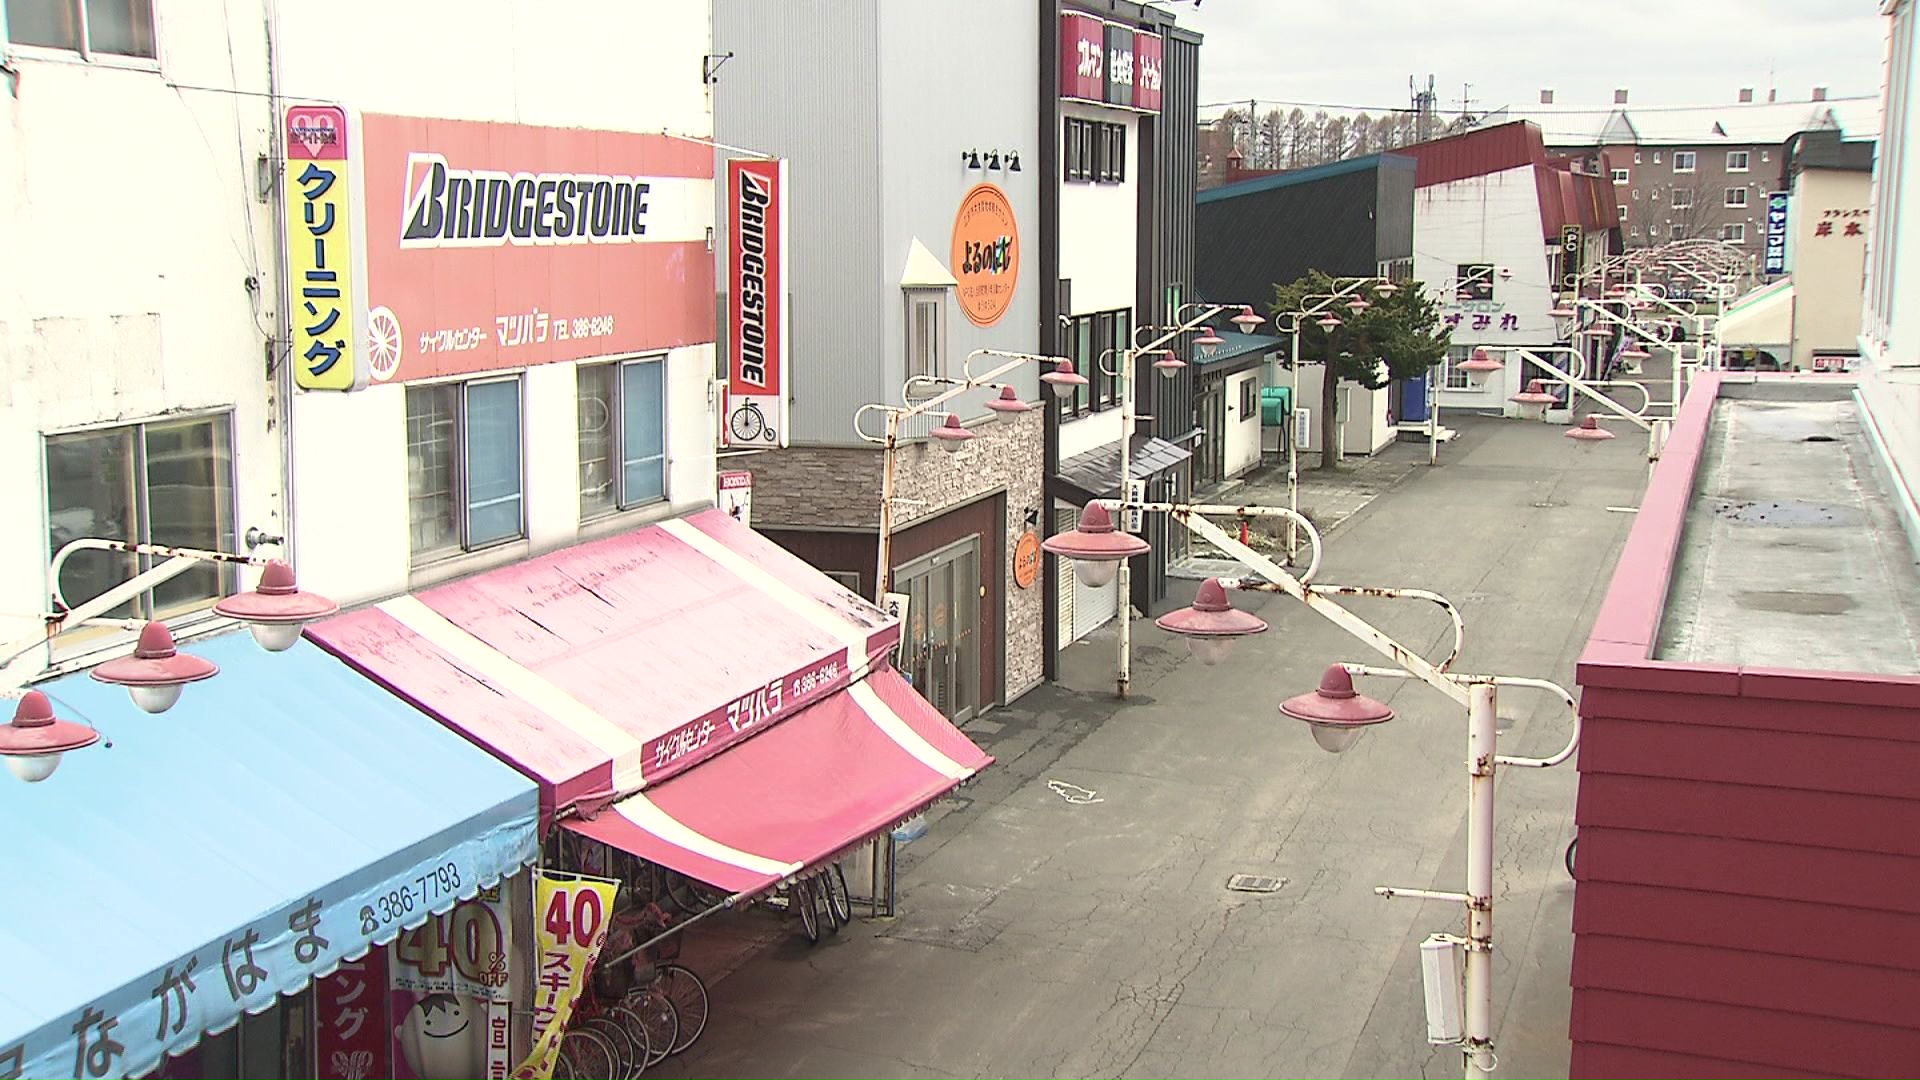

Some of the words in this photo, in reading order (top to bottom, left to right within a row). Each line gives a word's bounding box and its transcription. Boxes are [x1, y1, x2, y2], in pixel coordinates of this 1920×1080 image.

[402, 160, 651, 241] BRIDGESTONE
[296, 162, 346, 377] クリーニング
[741, 169, 769, 386] BRIDGESTONE
[419, 326, 488, 354] サイクルセンター
[552, 319, 570, 341] TEL
[723, 475, 751, 488] HONDA
[655, 719, 716, 768] サイクルセンター
[546, 889, 602, 948] 40
[72, 897, 329, 1079] ながはま
[377, 862, 462, 925] 386-7793
[479, 972, 508, 987] OFF
